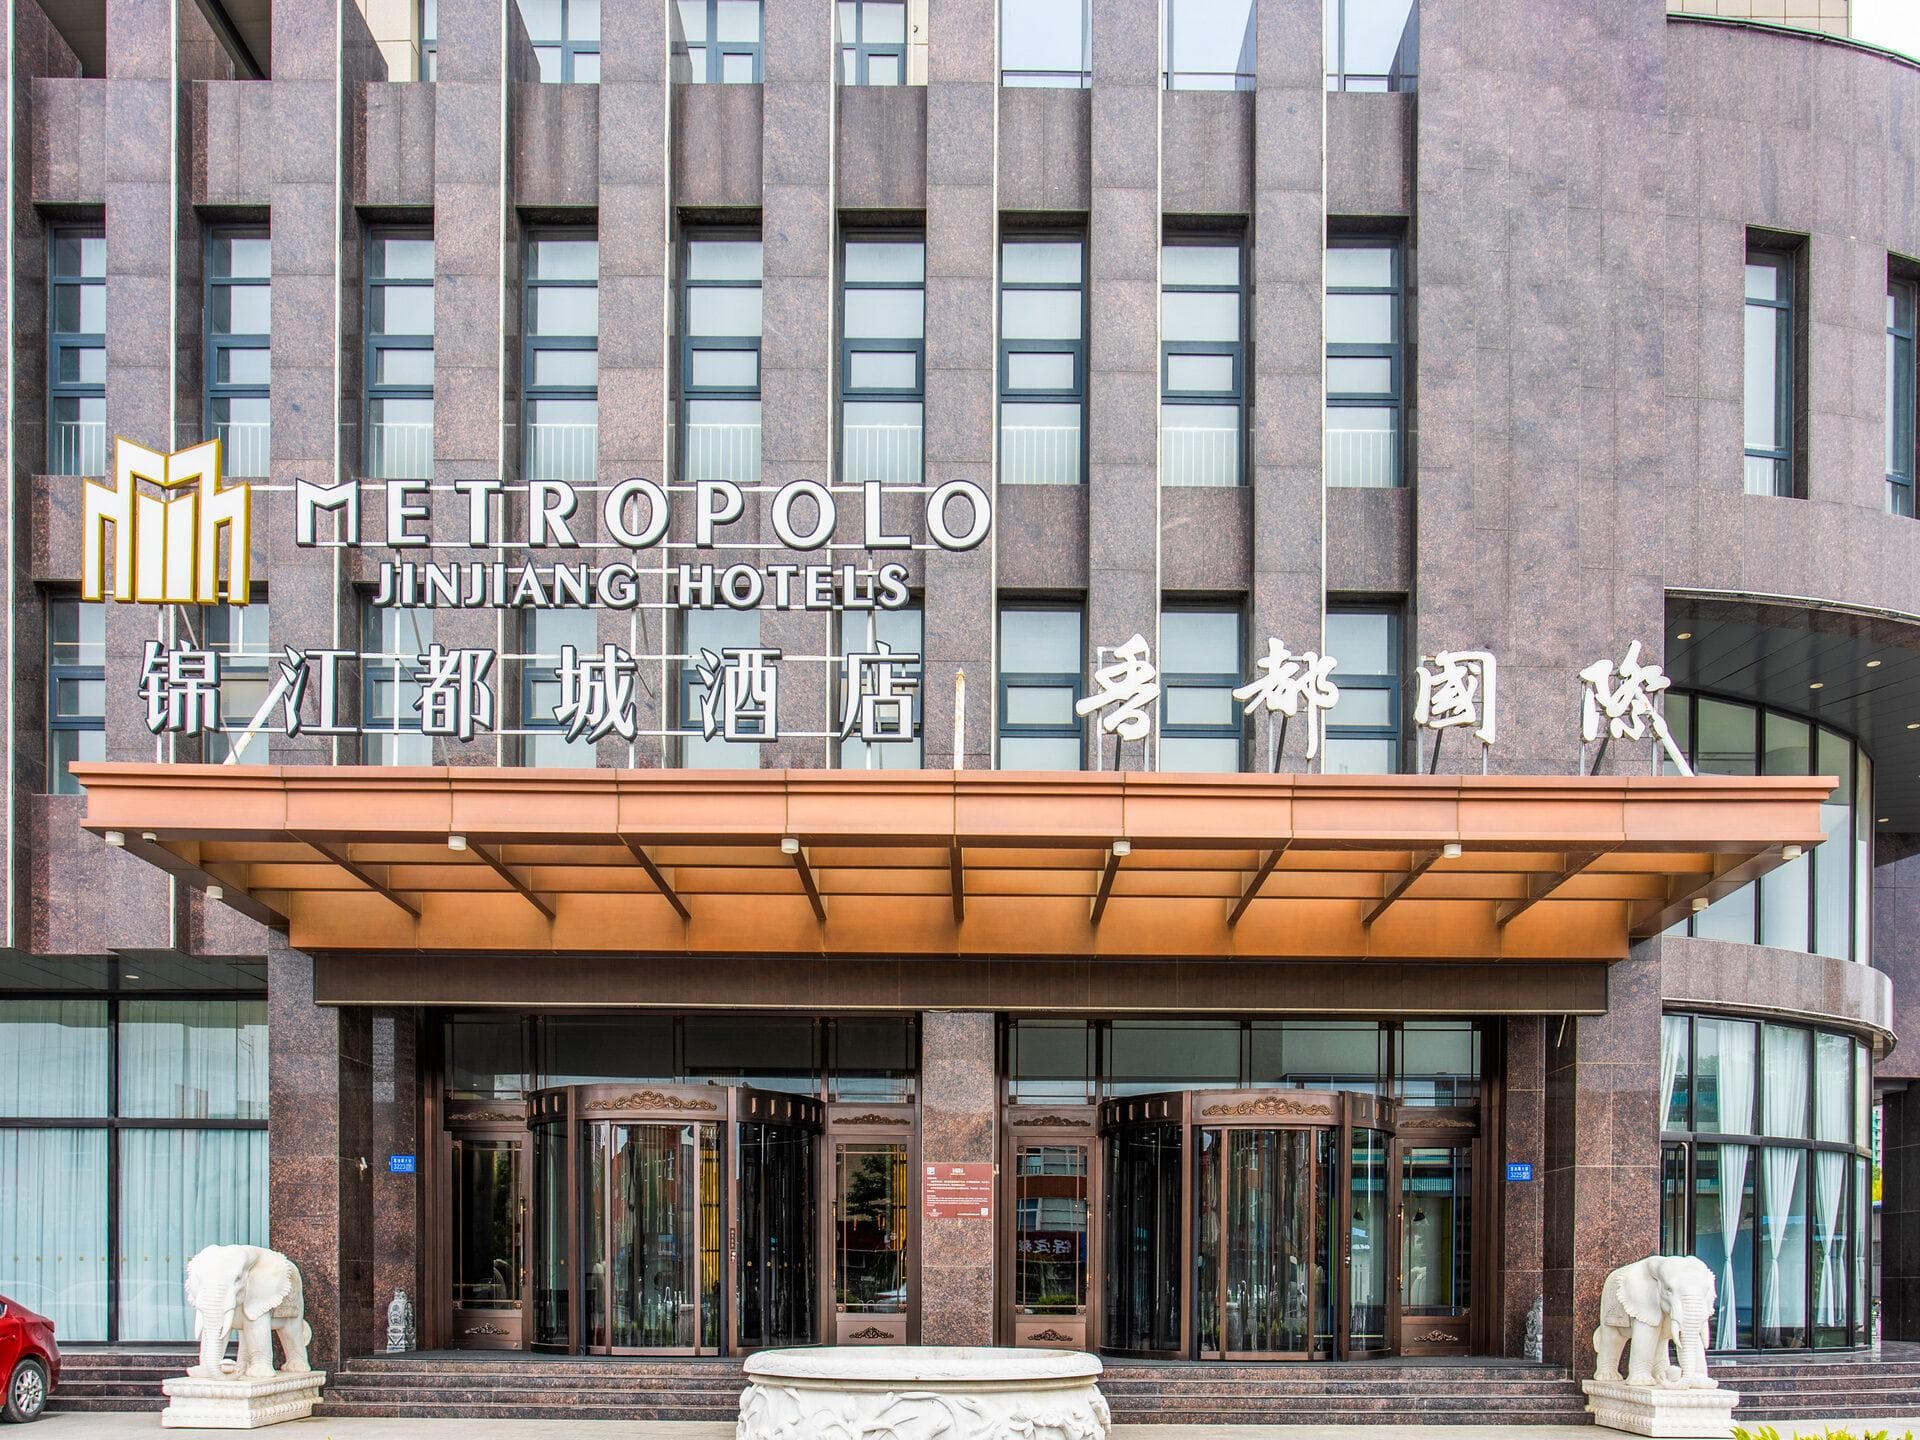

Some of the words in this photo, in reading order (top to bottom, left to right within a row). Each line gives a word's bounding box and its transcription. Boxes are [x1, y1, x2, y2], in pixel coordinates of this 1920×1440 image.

[294, 478, 993, 550] METROPOLO
[373, 562, 639, 609] JINJIANG
[677, 562, 911, 611] HOTELS
[138, 638, 921, 744] 锦江都城酒店
